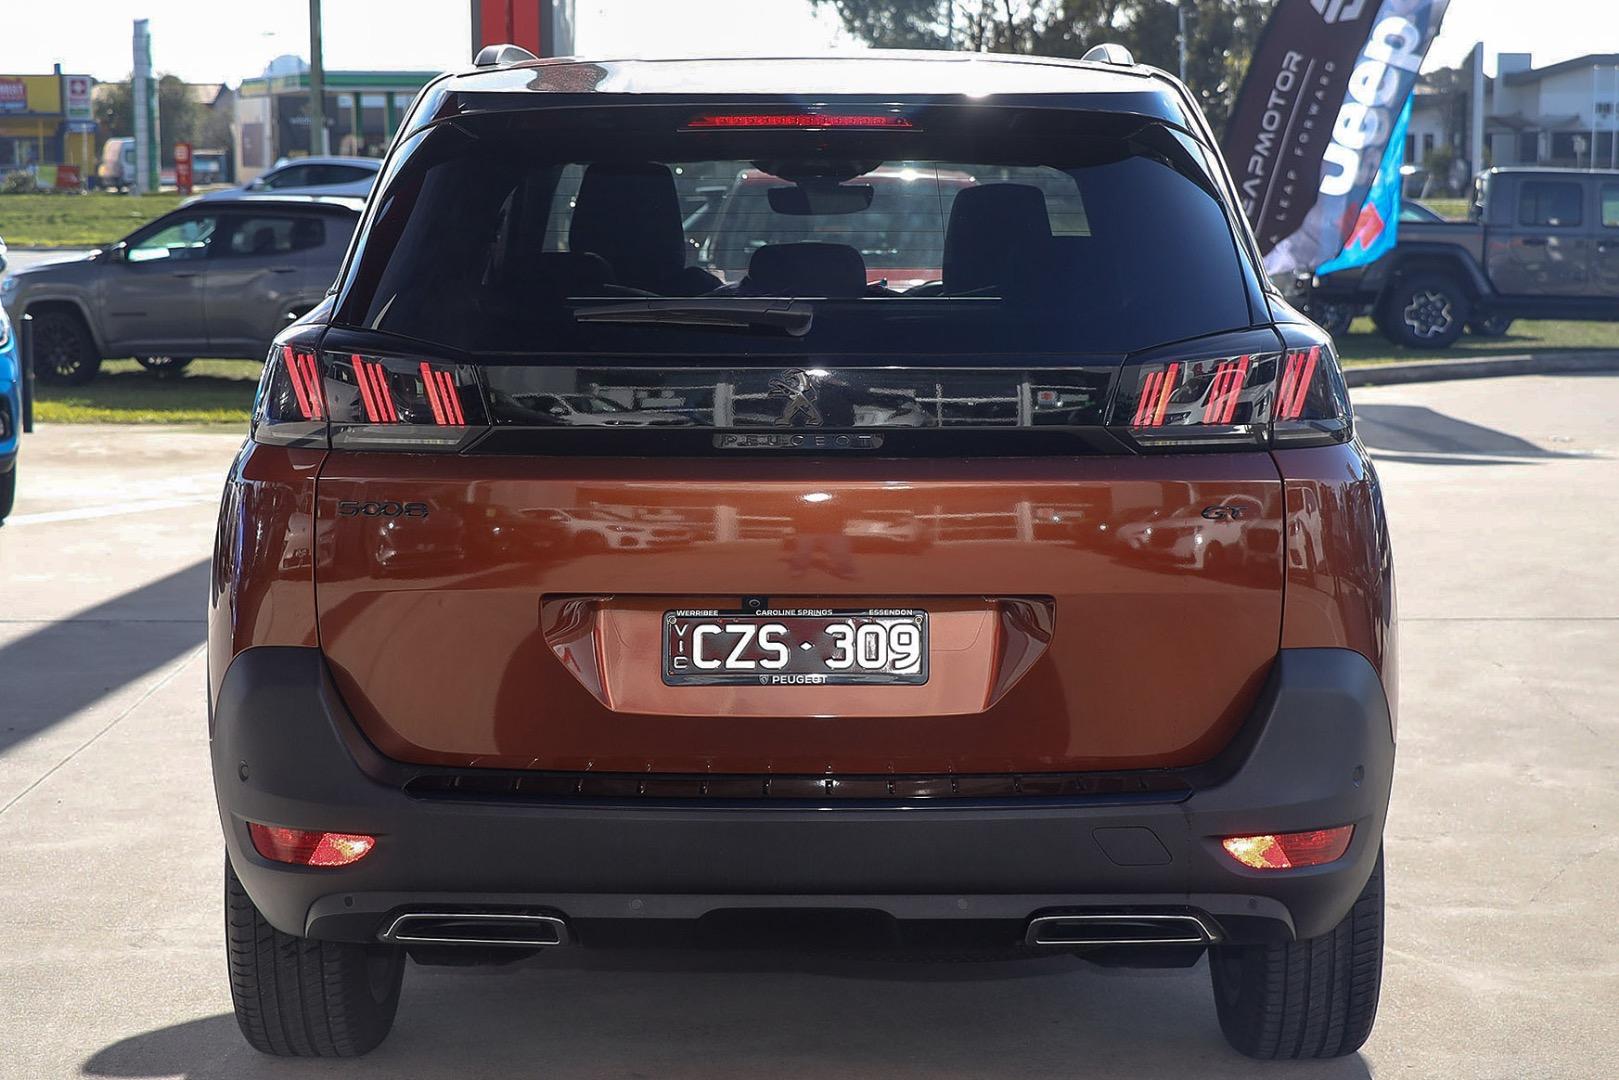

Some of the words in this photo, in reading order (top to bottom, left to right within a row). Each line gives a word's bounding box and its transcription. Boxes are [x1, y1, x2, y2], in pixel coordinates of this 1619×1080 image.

[1243, 51, 1304, 217] EAPMOTOR
[1276, 170, 1298, 222] LEAP
[1294, 61, 1336, 157] FORWARD
[723, 434, 872, 447] PEUGEOT
[338, 500, 429, 518] 5008
[1201, 505, 1248, 520] GT
[676, 609, 719, 617] WERRIBEE
[755, 609, 796, 617] CAROLINE
[797, 609, 833, 617] SPRINGS
[868, 608, 913, 616] ESSENDON
[673, 624, 689, 669] VIC
[692, 624, 789, 670] CZS
[824, 623, 921, 670] 309
[771, 675, 828, 684] PEUGEOT
